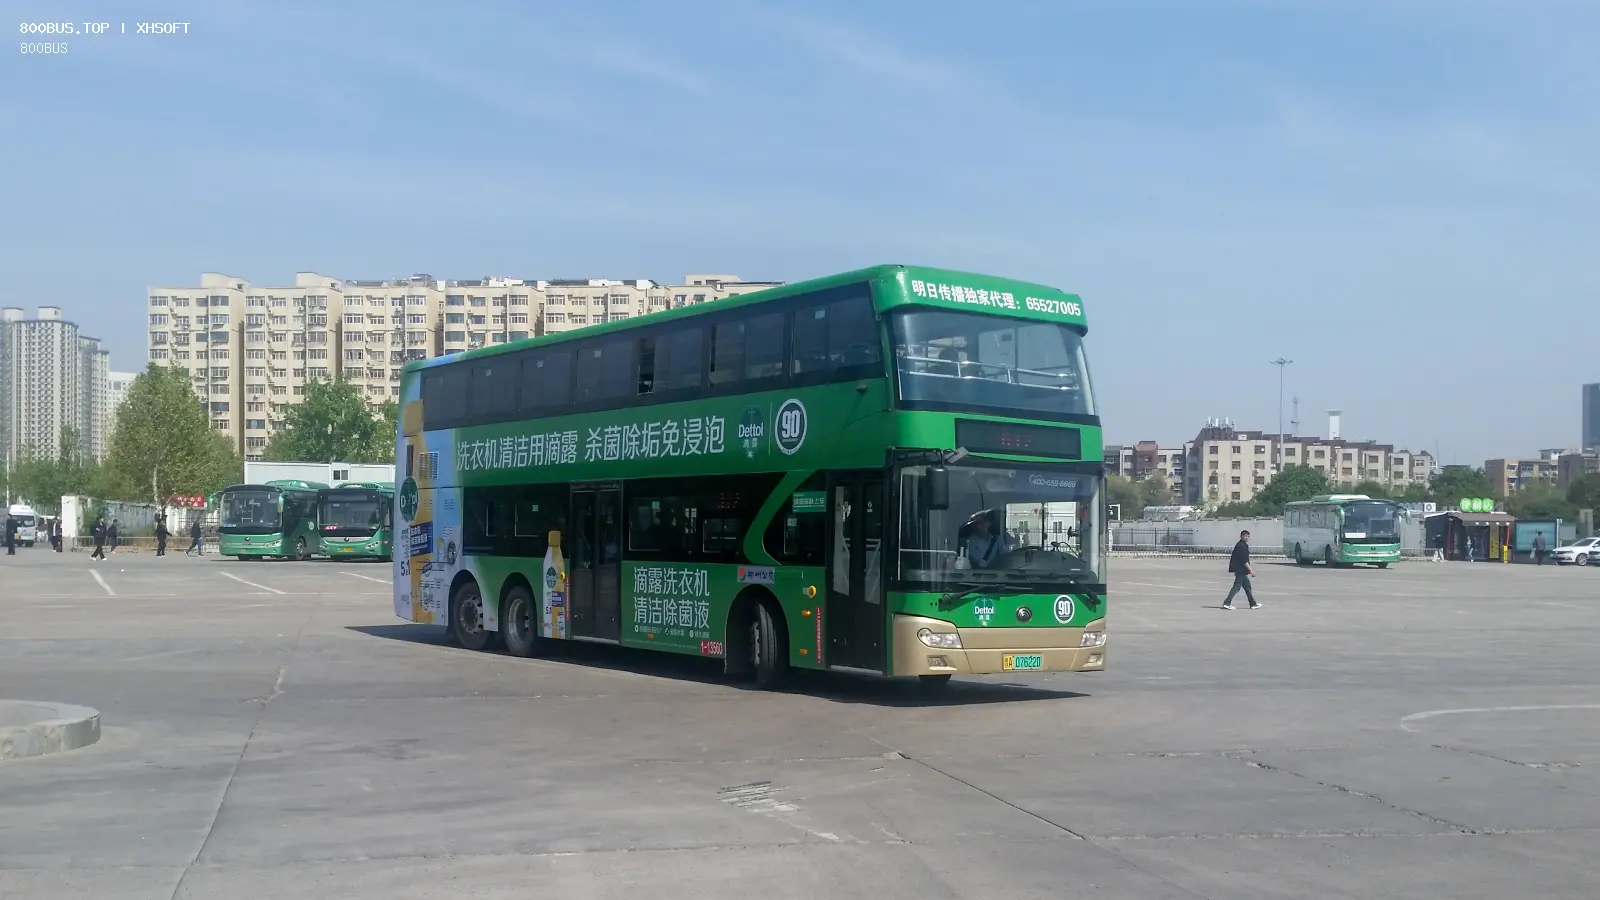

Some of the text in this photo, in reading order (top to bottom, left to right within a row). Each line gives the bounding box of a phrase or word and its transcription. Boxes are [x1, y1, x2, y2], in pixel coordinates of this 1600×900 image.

[1025, 296, 1082, 317] 65527005
[738, 422, 764, 438] Dettol
[782, 409, 800, 438] 90
[456, 415, 725, 472] 洗衣机清洁用滴露 杀菌除垢免浸泡
[633, 566, 710, 597] 滴露洗衣机
[633, 596, 710, 629] 清洁除菌液
[974, 606, 994, 615] Dettol
[1057, 600, 1071, 615] 90
